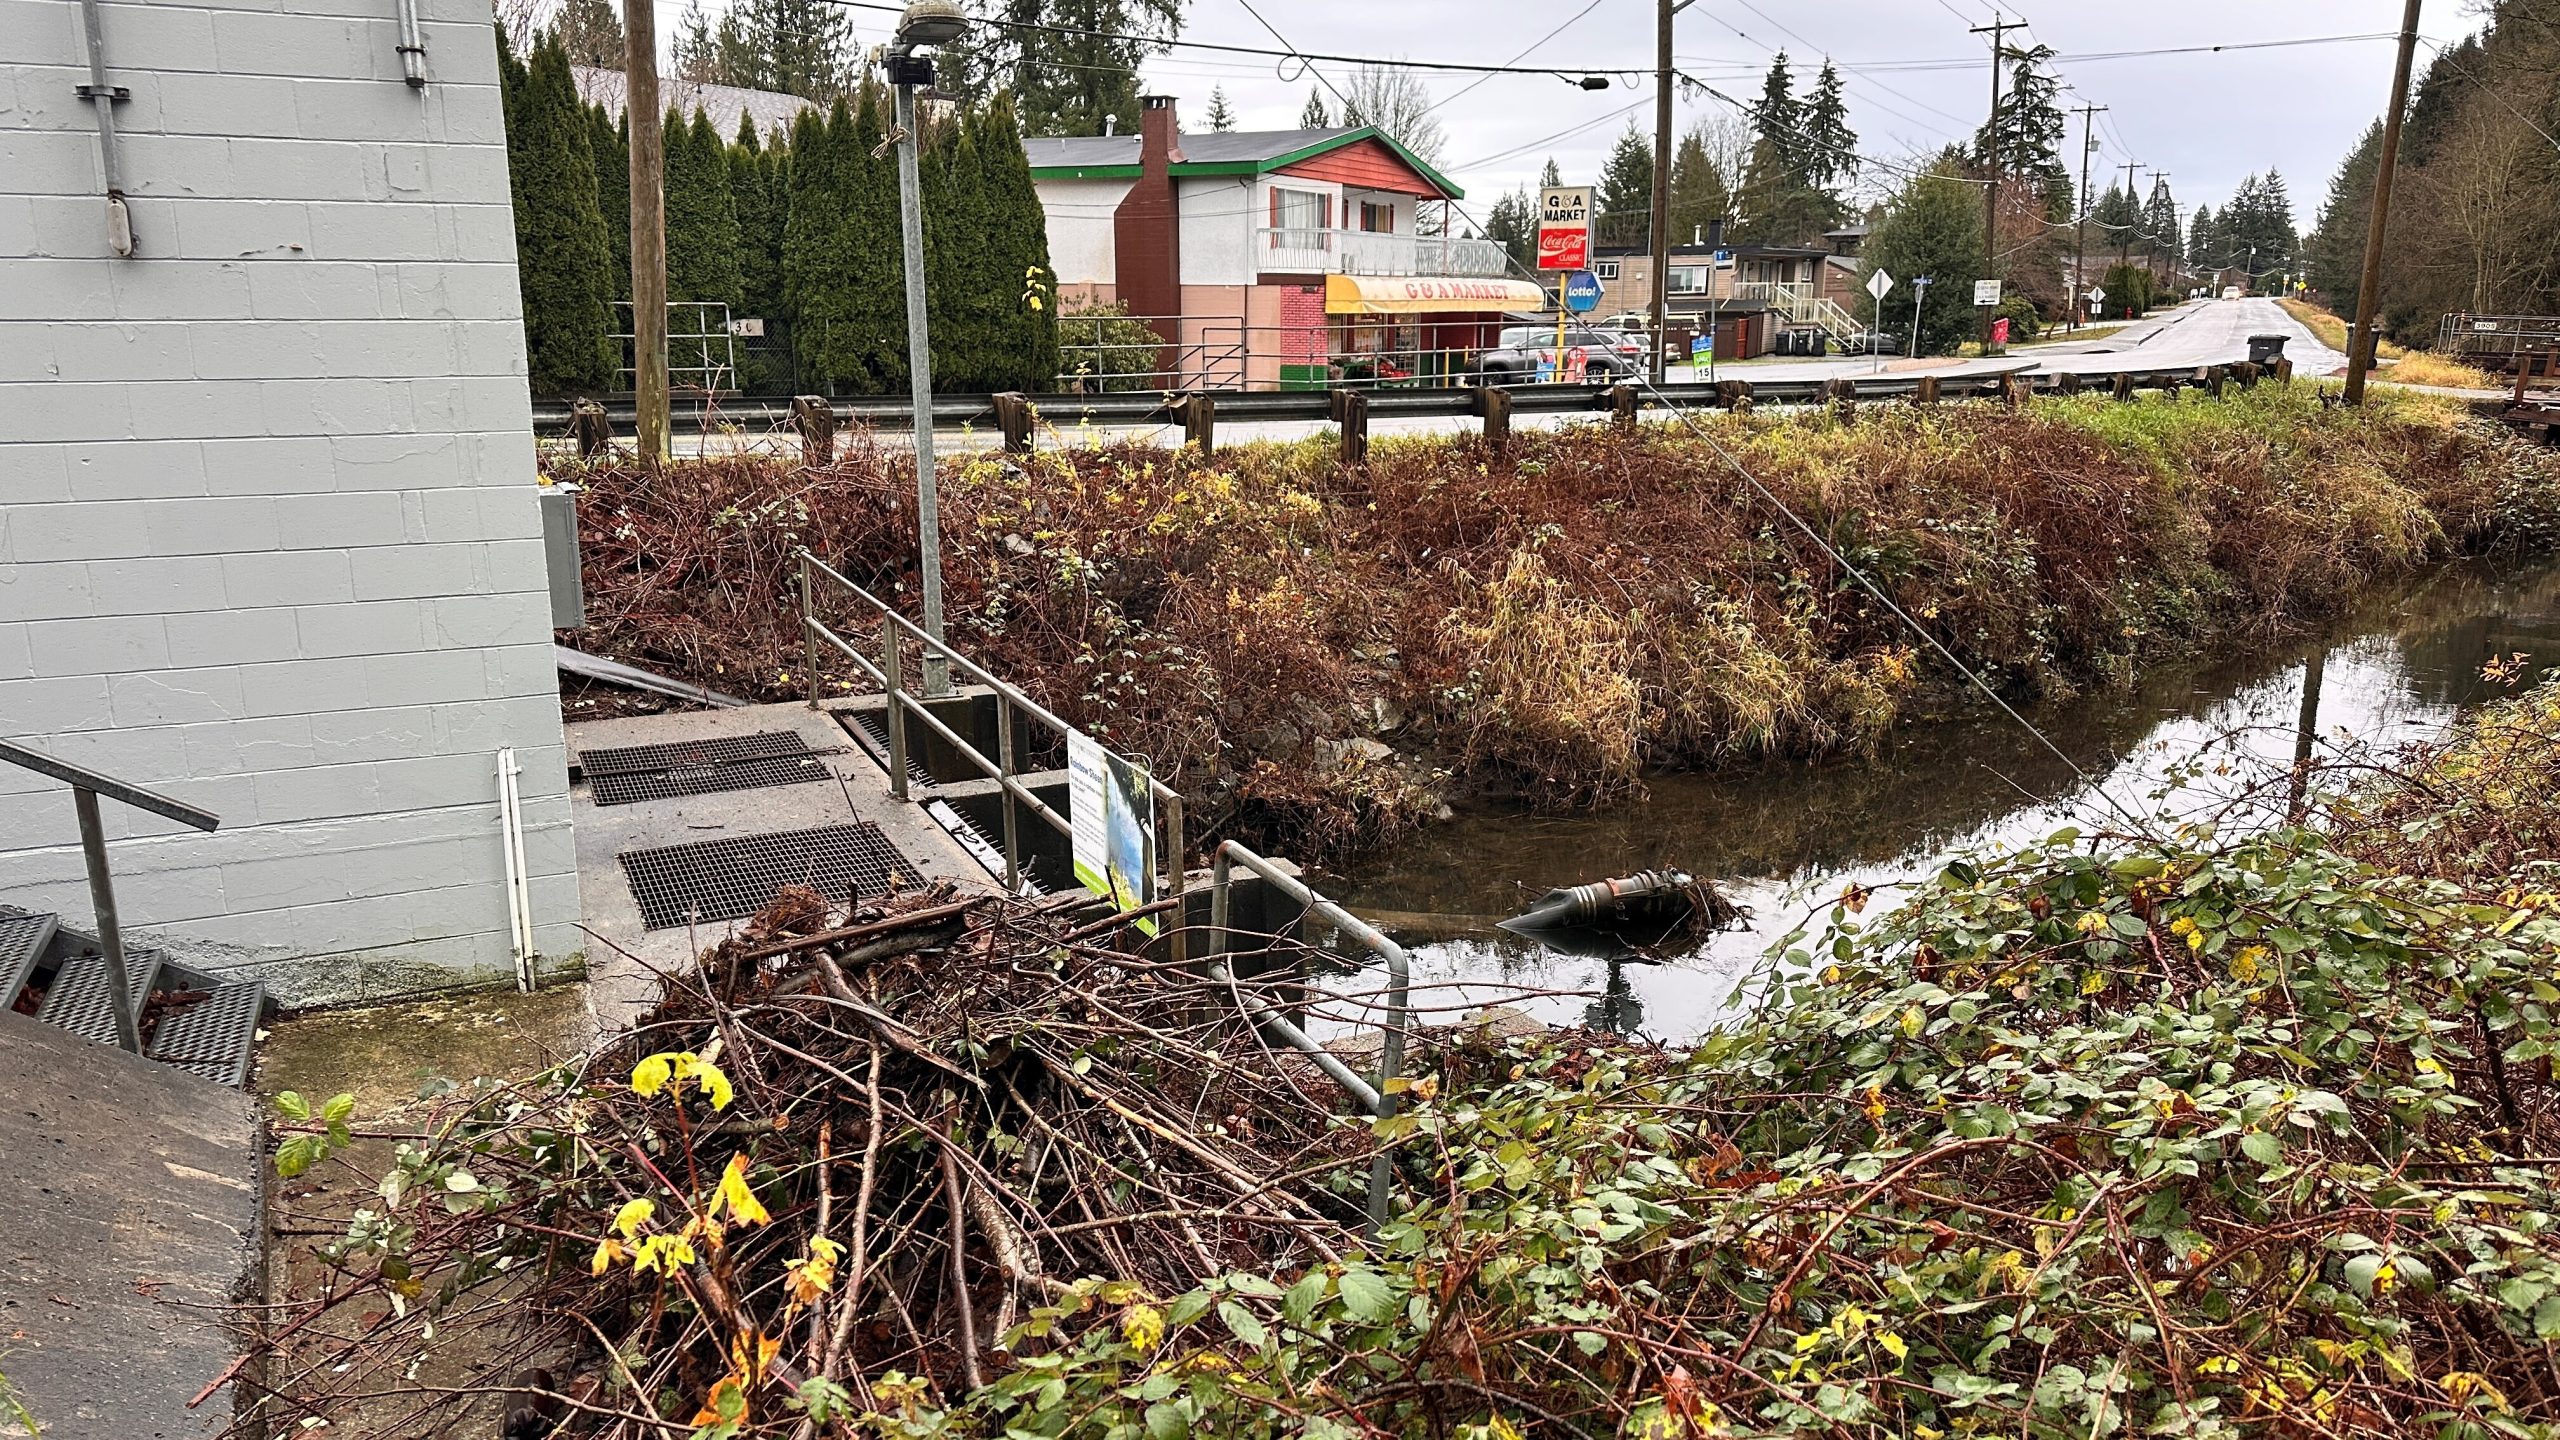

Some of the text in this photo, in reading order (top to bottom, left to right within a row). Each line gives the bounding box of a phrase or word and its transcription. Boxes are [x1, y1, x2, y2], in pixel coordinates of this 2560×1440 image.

[1545, 209, 1586, 222] MARKET
[1449, 283, 1509, 299] MARKET
[1698, 367, 1710, 377] 15
